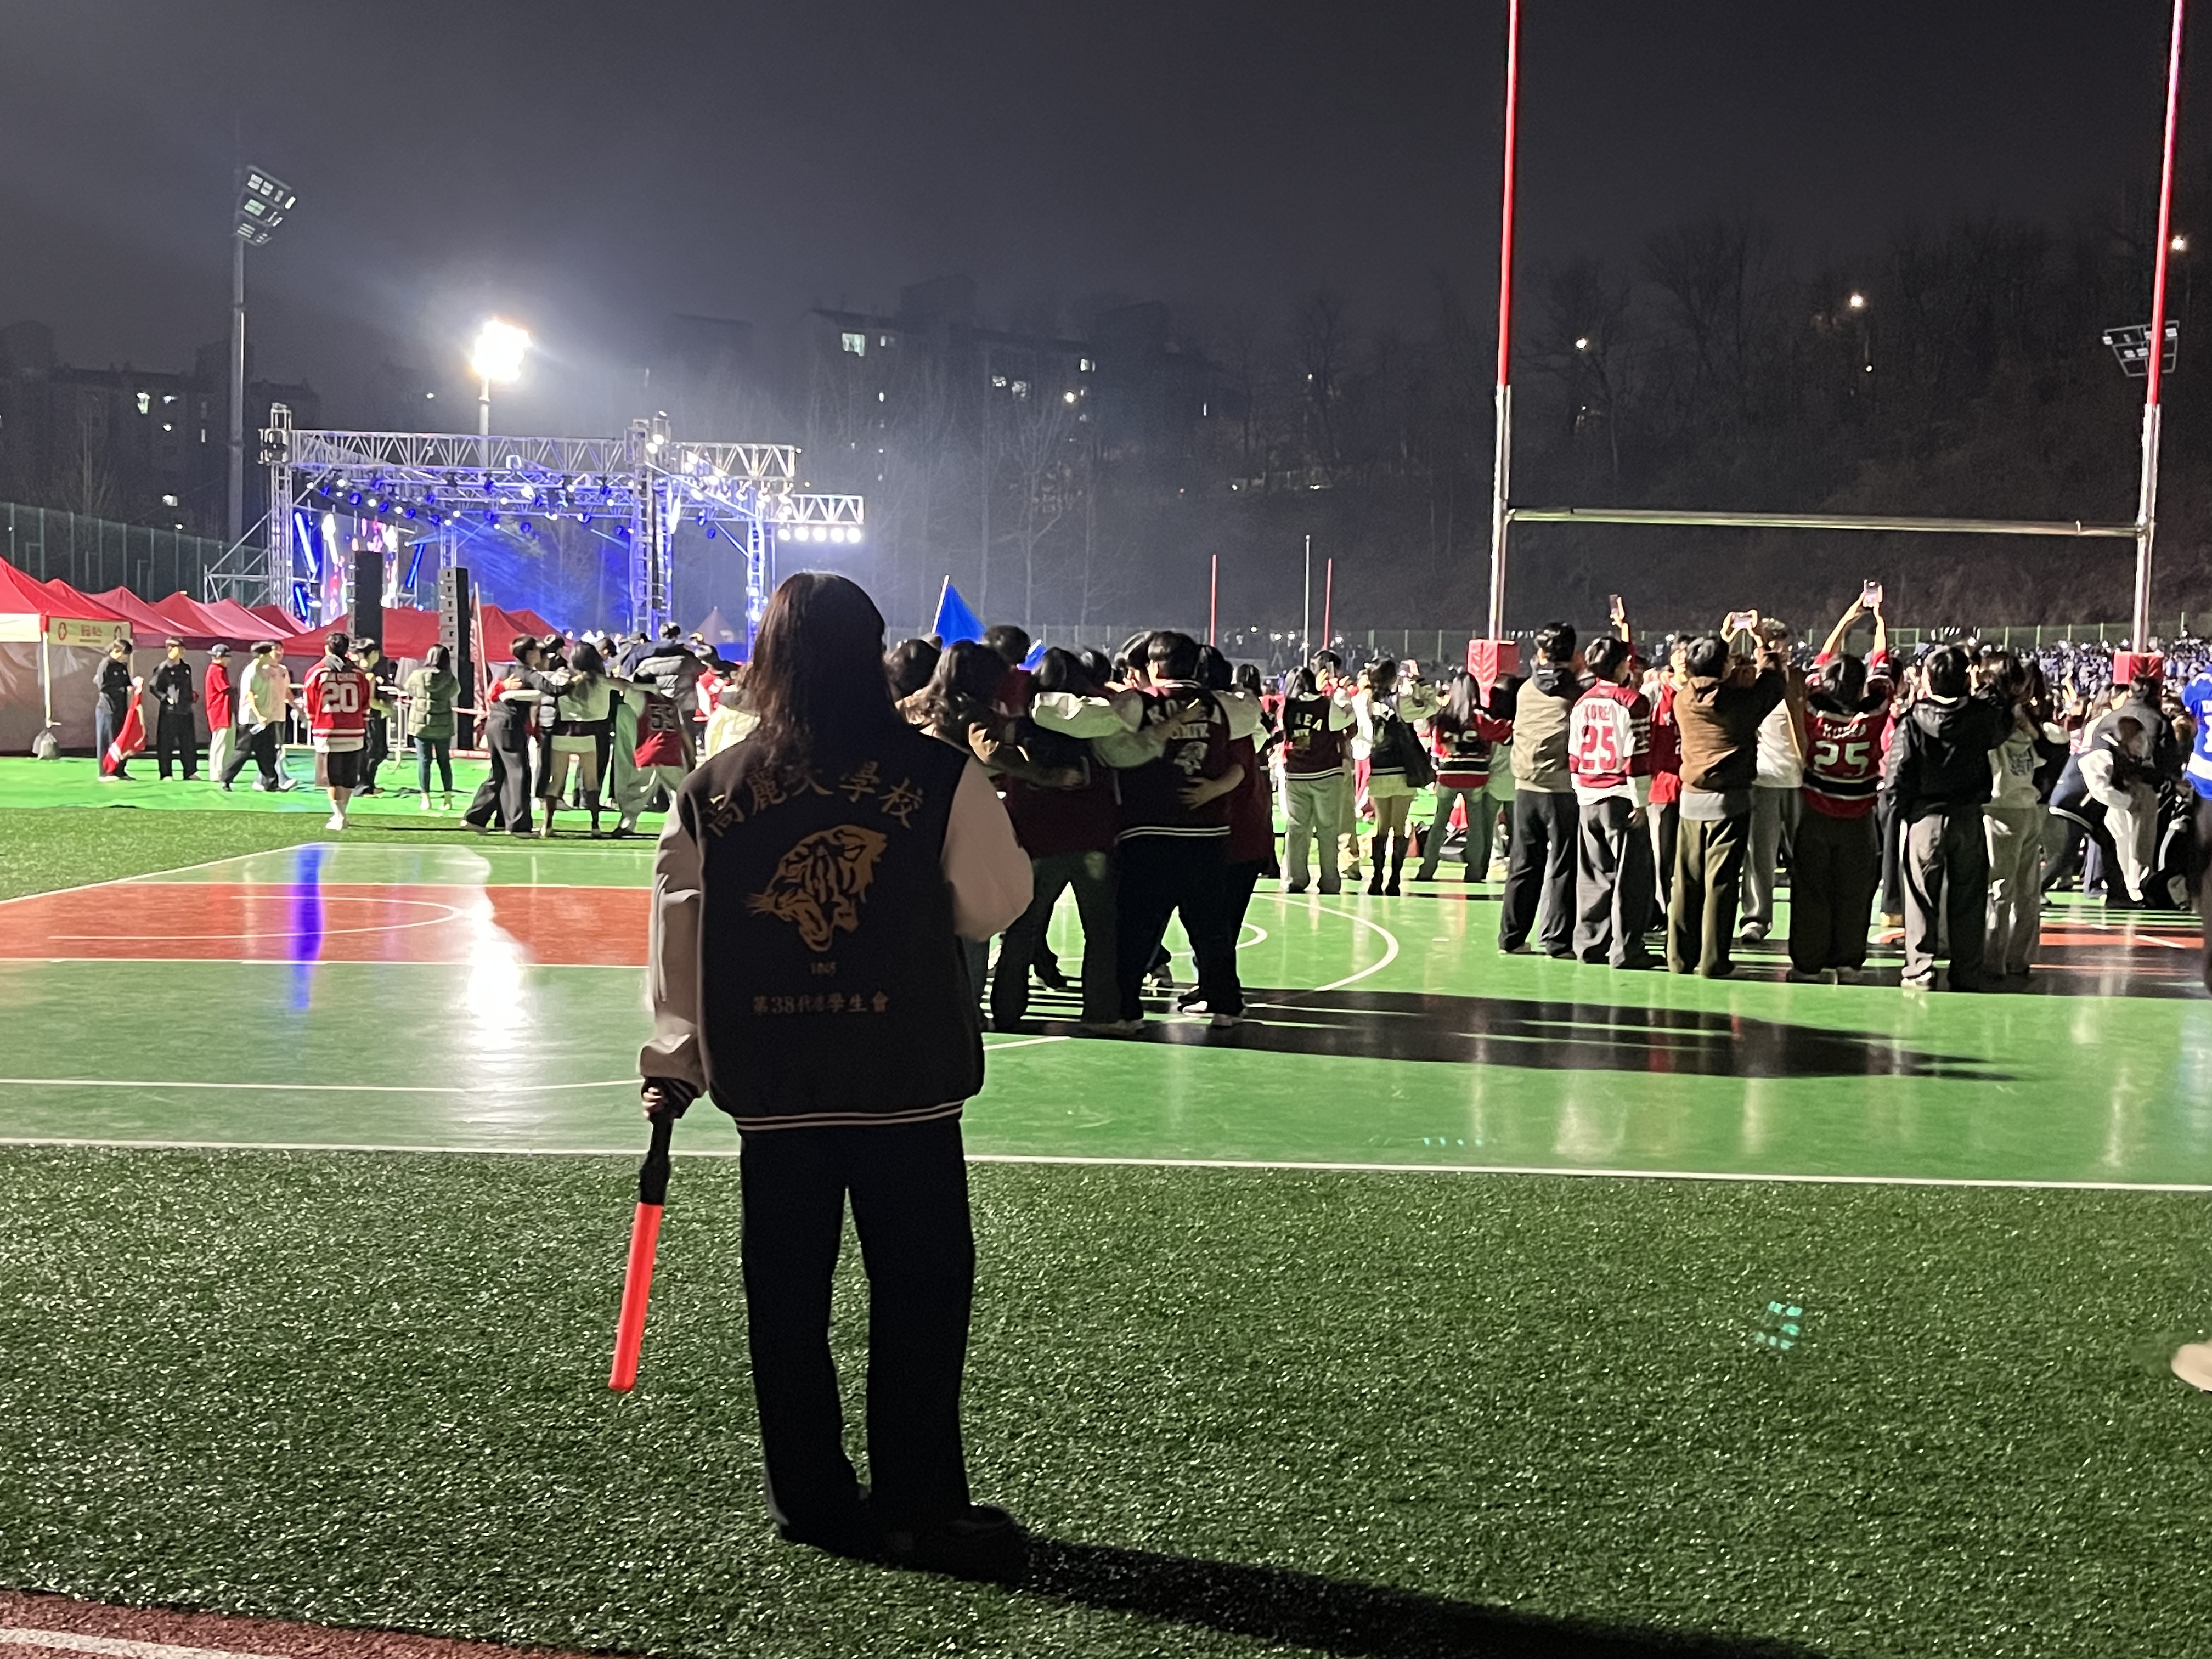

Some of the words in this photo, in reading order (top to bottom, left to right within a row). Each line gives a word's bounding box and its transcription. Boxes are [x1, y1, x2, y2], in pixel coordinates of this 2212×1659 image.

[321, 682, 359, 713] 20
[1580, 725, 1617, 770] 25
[1813, 740, 1871, 777] 25
